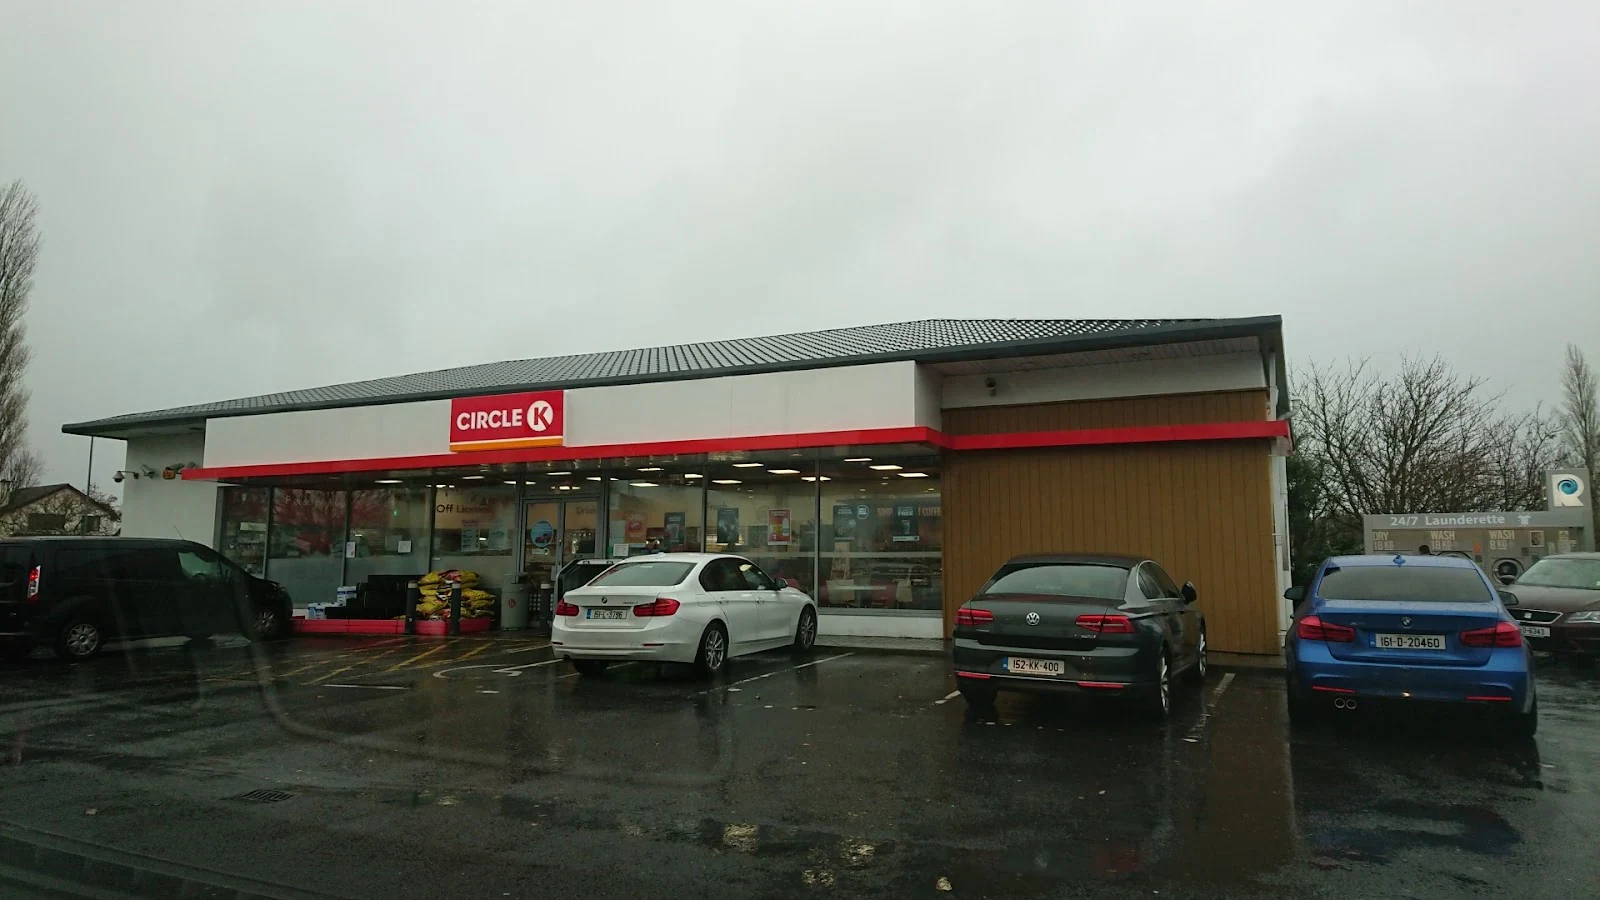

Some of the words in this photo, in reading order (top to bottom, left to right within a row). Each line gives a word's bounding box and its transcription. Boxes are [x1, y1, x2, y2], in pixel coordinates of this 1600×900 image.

[456, 408, 523, 431] CIRCLE
[531, 403, 552, 431] K
[436, 504, 454, 514] Off
[457, 504, 491, 514] Licen
[1390, 516, 1418, 527] 24/7
[1425, 515, 1505, 526] Launderette
[1373, 531, 1388, 541] DRY
[1430, 530, 1456, 541] WASH
[1489, 530, 1515, 540] WASH
[1373, 540, 1383, 550] 18
[1431, 540, 1441, 550] 18
[1489, 540, 1495, 549] 8
[1380, 636, 1440, 648] 161-D-20460
[1013, 659, 1059, 672] 152-KK-400
